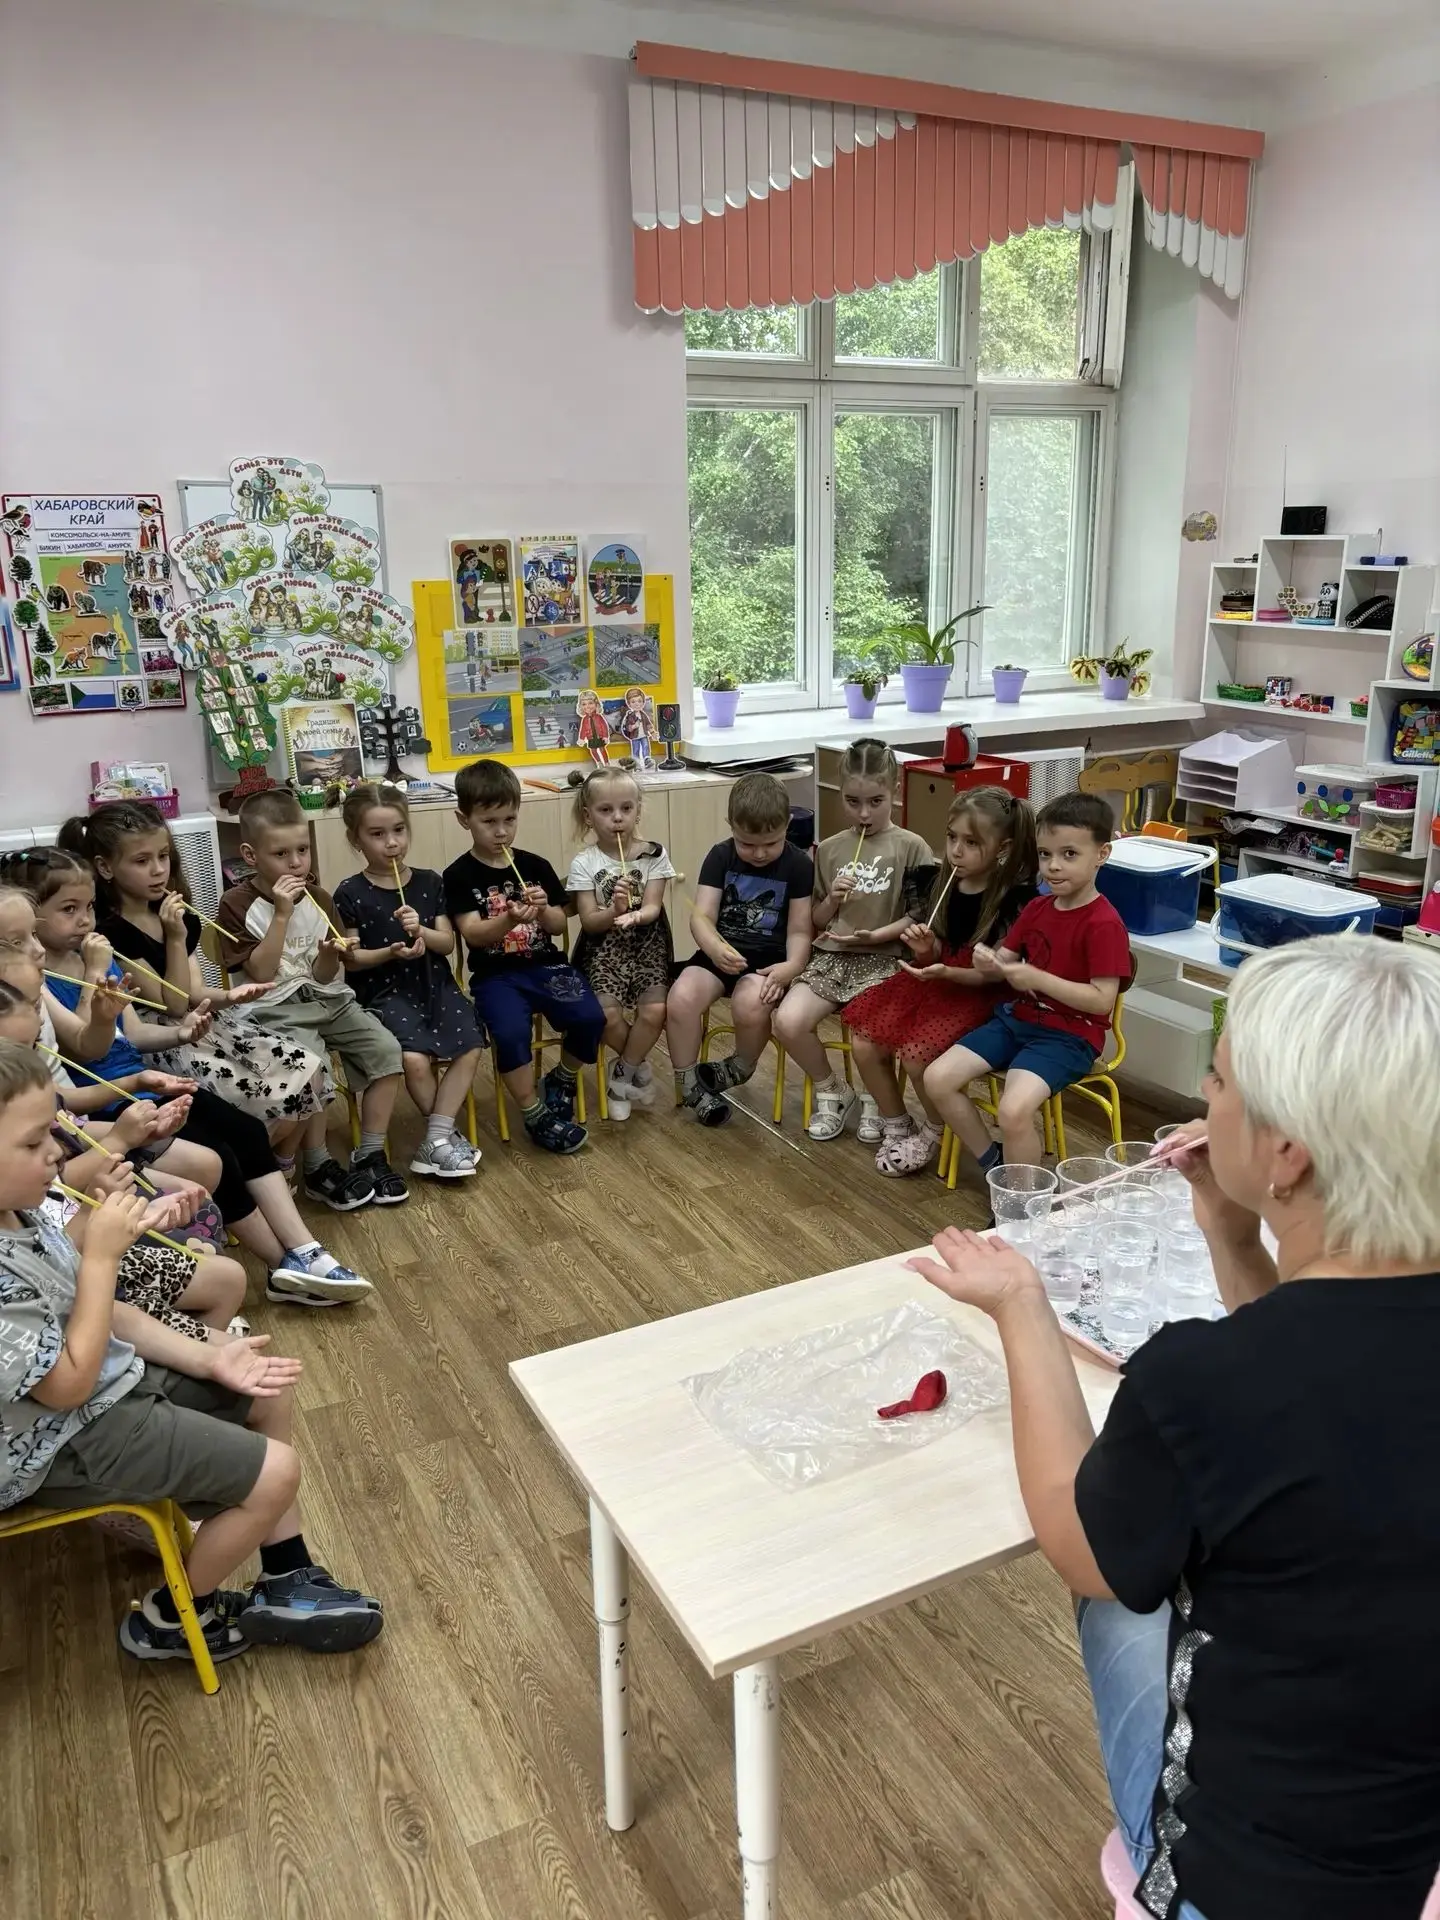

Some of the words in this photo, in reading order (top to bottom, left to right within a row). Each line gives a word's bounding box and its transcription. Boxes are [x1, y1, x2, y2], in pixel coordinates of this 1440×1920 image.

[234, 460, 260, 473] СЕМЬЯ
[267, 458, 284, 466] ЭТО
[279, 467, 303, 478] ДЕТИ
[34, 498, 135, 511] ХАБАРОВСКИЙ
[70, 512, 105, 525] КРАЙ
[293, 516, 320, 525] СЕМЬЯ
[326, 516, 342, 526] ЭТО
[202, 522, 248, 539] УВАЖЕНИЕ
[318, 523, 350, 536] СЕРДЦЕ
[350, 532, 372, 550] ДОМА
[174, 531, 196, 554] СЕМЬЯ
[198, 520, 215, 532] ЭТО
[67, 542, 103, 550] ХАБАРОВСК
[246, 575, 272, 591] СЕМЬЯ
[284, 580, 317, 589] ЛЮБОВЬ
[368, 589, 383, 600] ЭТО
[164, 608, 186, 628] СЕМЬЯ
[191, 598, 207, 609] ЭТО
[197, 602, 236, 614] РАДОСТЬ
[361, 596, 388, 612] ОБЩИЕ
[388, 609, 406, 626] ДЕЛА
[237, 646, 252, 656] ЭТО
[298, 644, 324, 656] СЕМЬЯ
[242, 651, 279, 662] ПОМОЩЬ
[325, 650, 374, 668] ПОДДЕРЖКА
[305, 719, 340, 728] Традиции
